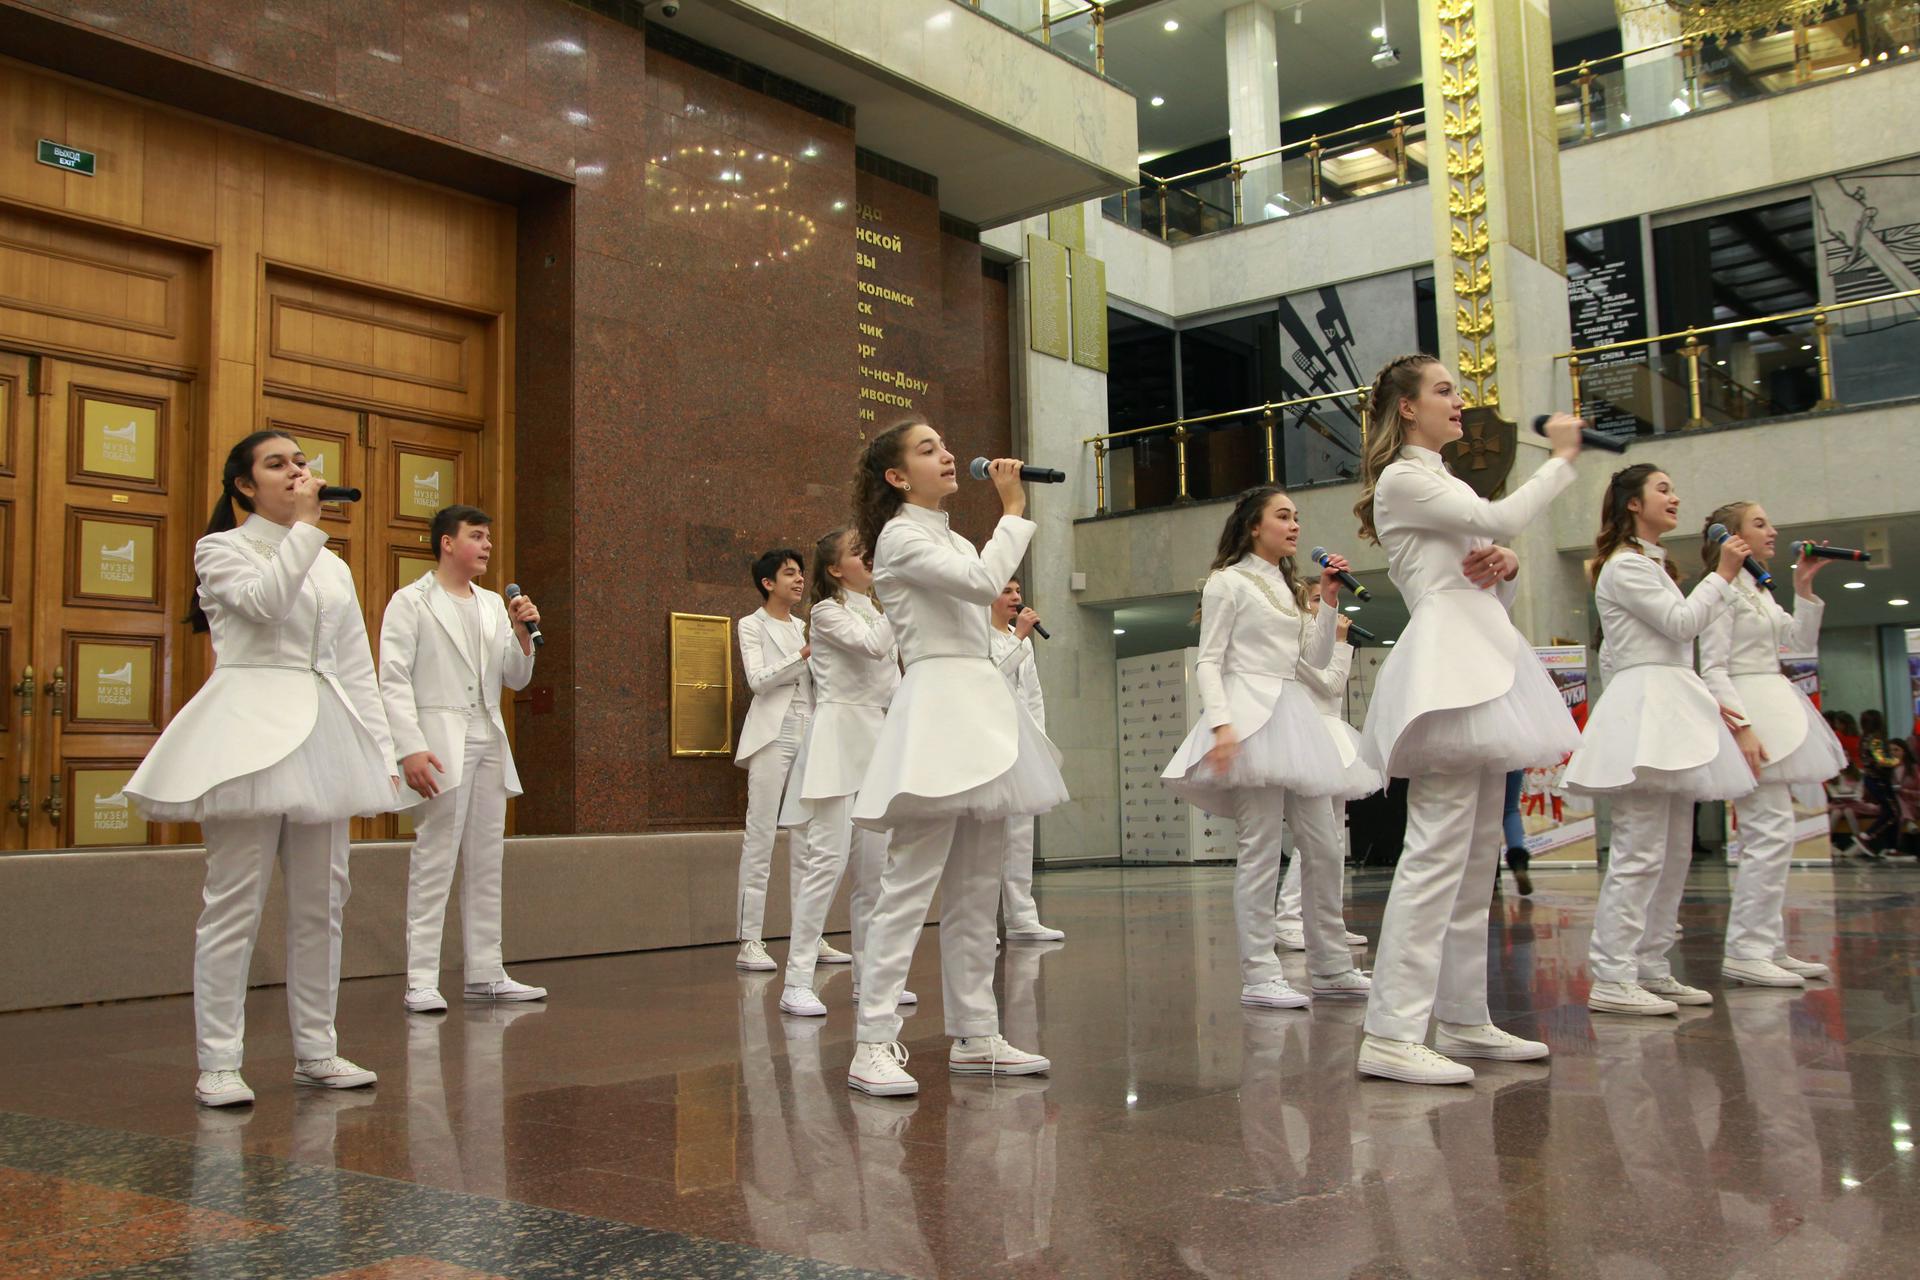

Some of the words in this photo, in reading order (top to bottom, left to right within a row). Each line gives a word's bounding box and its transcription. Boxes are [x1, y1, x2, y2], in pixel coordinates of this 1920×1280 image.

[53, 147, 81, 162] ВЫХОД
[59, 157, 75, 167] EXIT
[856, 227, 902, 253] нской
[856, 252, 876, 270] вы
[857, 281, 915, 308] коламск
[1602, 293, 1628, 302] POLAND
[858, 302, 873, 316] ск
[1596, 314, 1615, 323] INDIA
[1583, 325, 1609, 335] CANADA
[1612, 320, 1629, 329] USA
[1593, 337, 1615, 347] USSR
[1600, 351, 1625, 361] CHINA
[858, 365, 929, 396] ч-на-Дону
[1604, 374, 1633, 385] ZEALAND
[859, 387, 913, 410] ивосток
[414, 490, 439, 501] МУЗЕЙ
[414, 497, 439, 507] ПОБЕДЫ
[101, 563, 134, 573] МУЗЕЙ
[101, 571, 134, 583] ПОБЕДЫ
[98, 687, 131, 697] МУЗЕЙ
[98, 695, 131, 705] ПОБЕДЫ
[95, 810, 128, 820] МУЗЕЙ
[95, 820, 128, 829] ПОБЕДЫ
